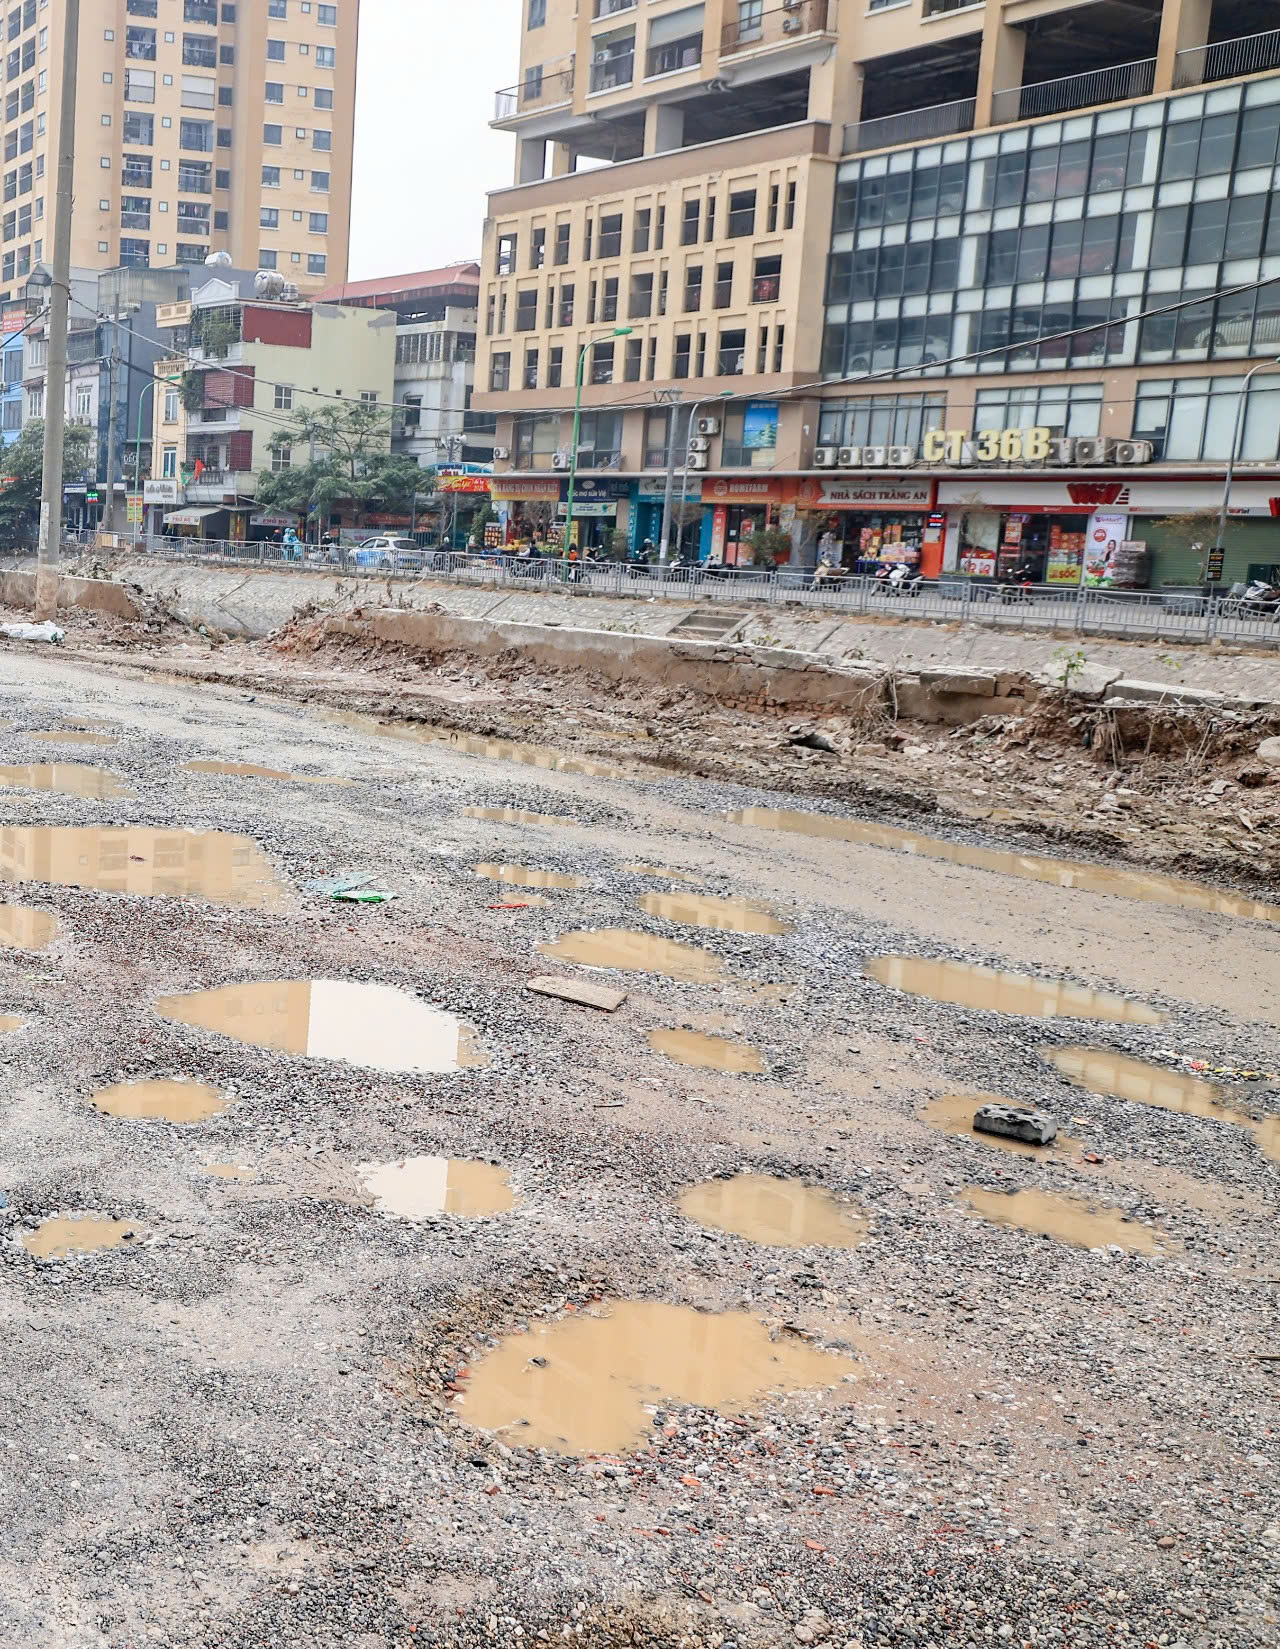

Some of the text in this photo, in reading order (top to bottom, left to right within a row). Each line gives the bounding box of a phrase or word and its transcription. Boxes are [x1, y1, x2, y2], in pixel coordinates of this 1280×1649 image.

[923, 427, 1050, 461] CT 36B
[729, 484, 768, 493] HOMEFARM
[830, 489, 927, 499] NHÀ SÁCH TRÀNG AN
